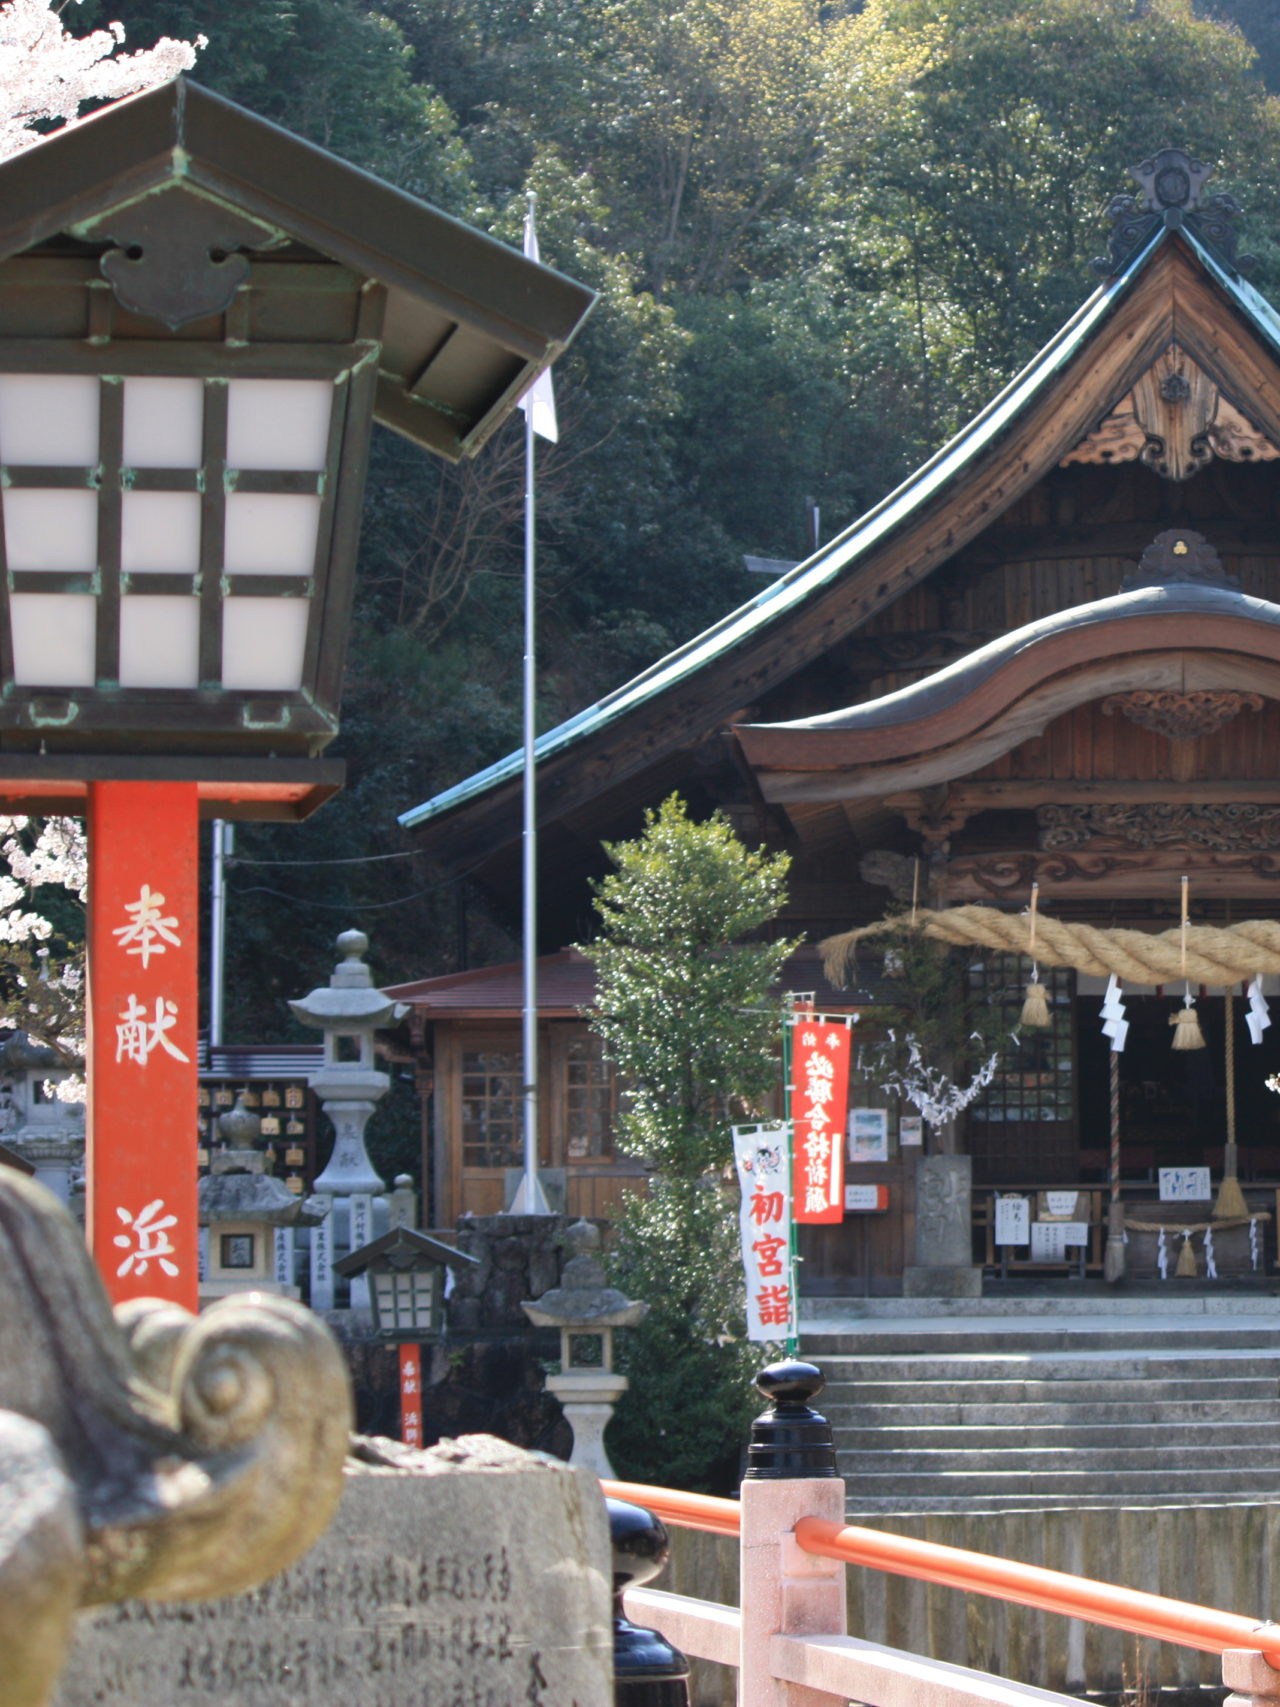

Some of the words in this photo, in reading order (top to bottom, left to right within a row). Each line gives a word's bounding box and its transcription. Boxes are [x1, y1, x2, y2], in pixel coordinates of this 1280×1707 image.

[113, 884, 190, 1065] 奉献
[113, 1199, 179, 1277] 浜
[748, 1185, 791, 1326] 初宮詣
